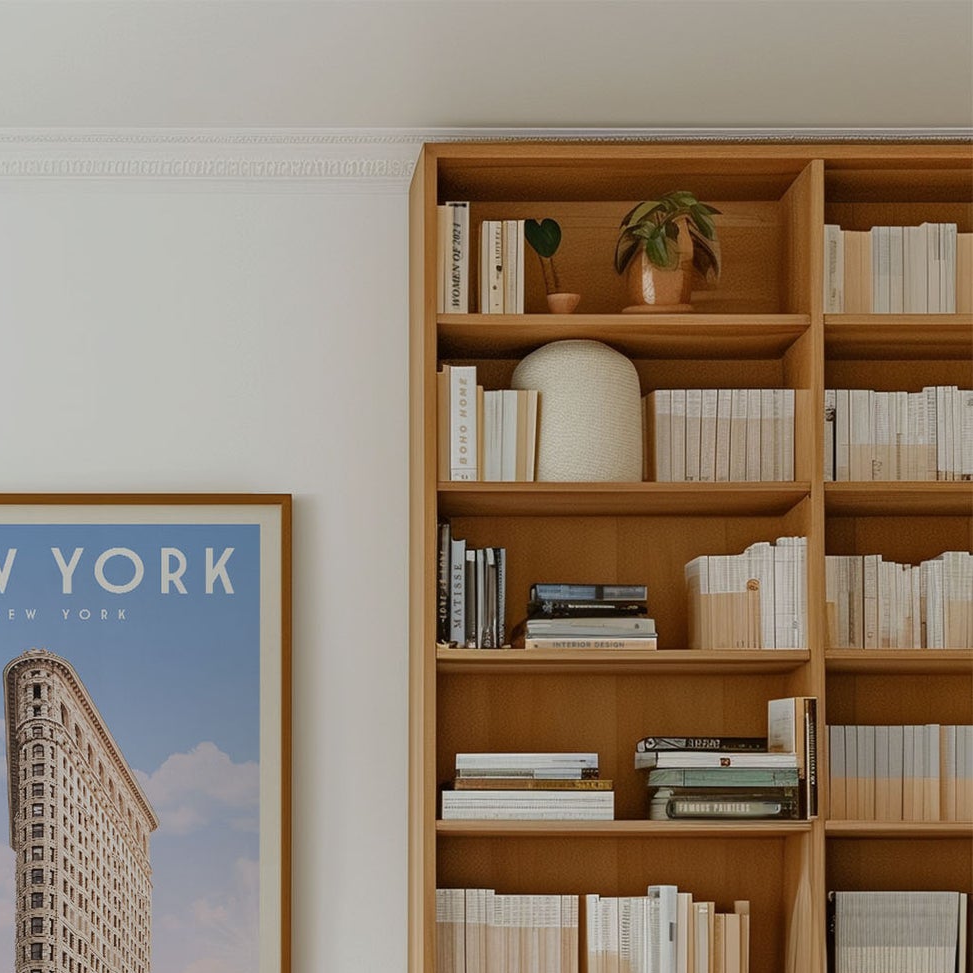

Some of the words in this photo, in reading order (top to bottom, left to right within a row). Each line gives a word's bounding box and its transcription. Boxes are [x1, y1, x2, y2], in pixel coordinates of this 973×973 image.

[451, 246, 461, 262] OF
[451, 264, 460, 307] WOMEN
[459, 377, 467, 418] HOME
[459, 425, 467, 465] BOHO
[52, 547, 235, 594] YORK
[62, 609, 128, 620] YORK
[453, 563, 462, 629] MATISSE
[678, 803, 710, 813] FAMOUS
[713, 803, 750, 813] PAINTERS
